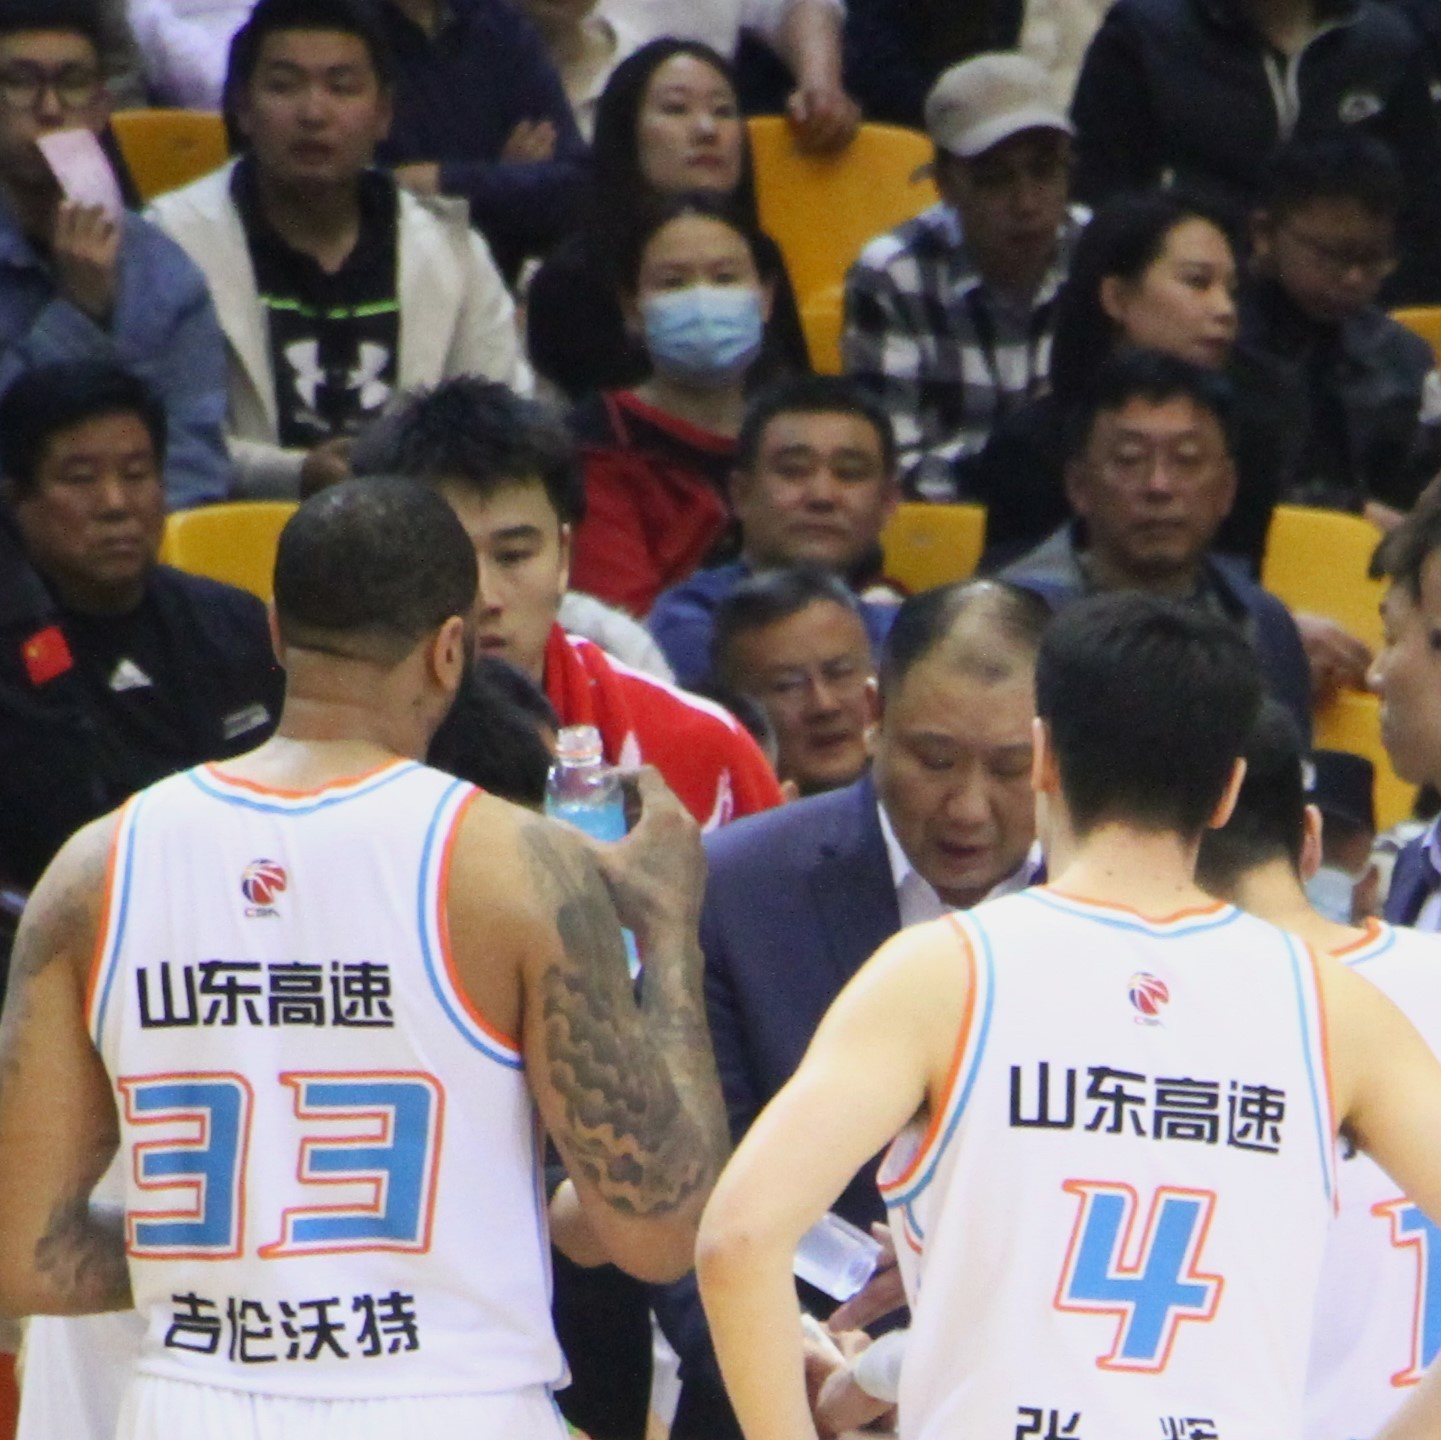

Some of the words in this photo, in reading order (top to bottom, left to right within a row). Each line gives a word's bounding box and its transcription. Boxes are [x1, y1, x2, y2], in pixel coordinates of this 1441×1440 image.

[137, 960, 394, 1029] 山东高速
[1009, 1062, 1286, 1154] 山东高速
[117, 1071, 446, 1261] 33
[1053, 1178, 1225, 1375] 4
[164, 1292, 421, 1363] 吉伦沃特
